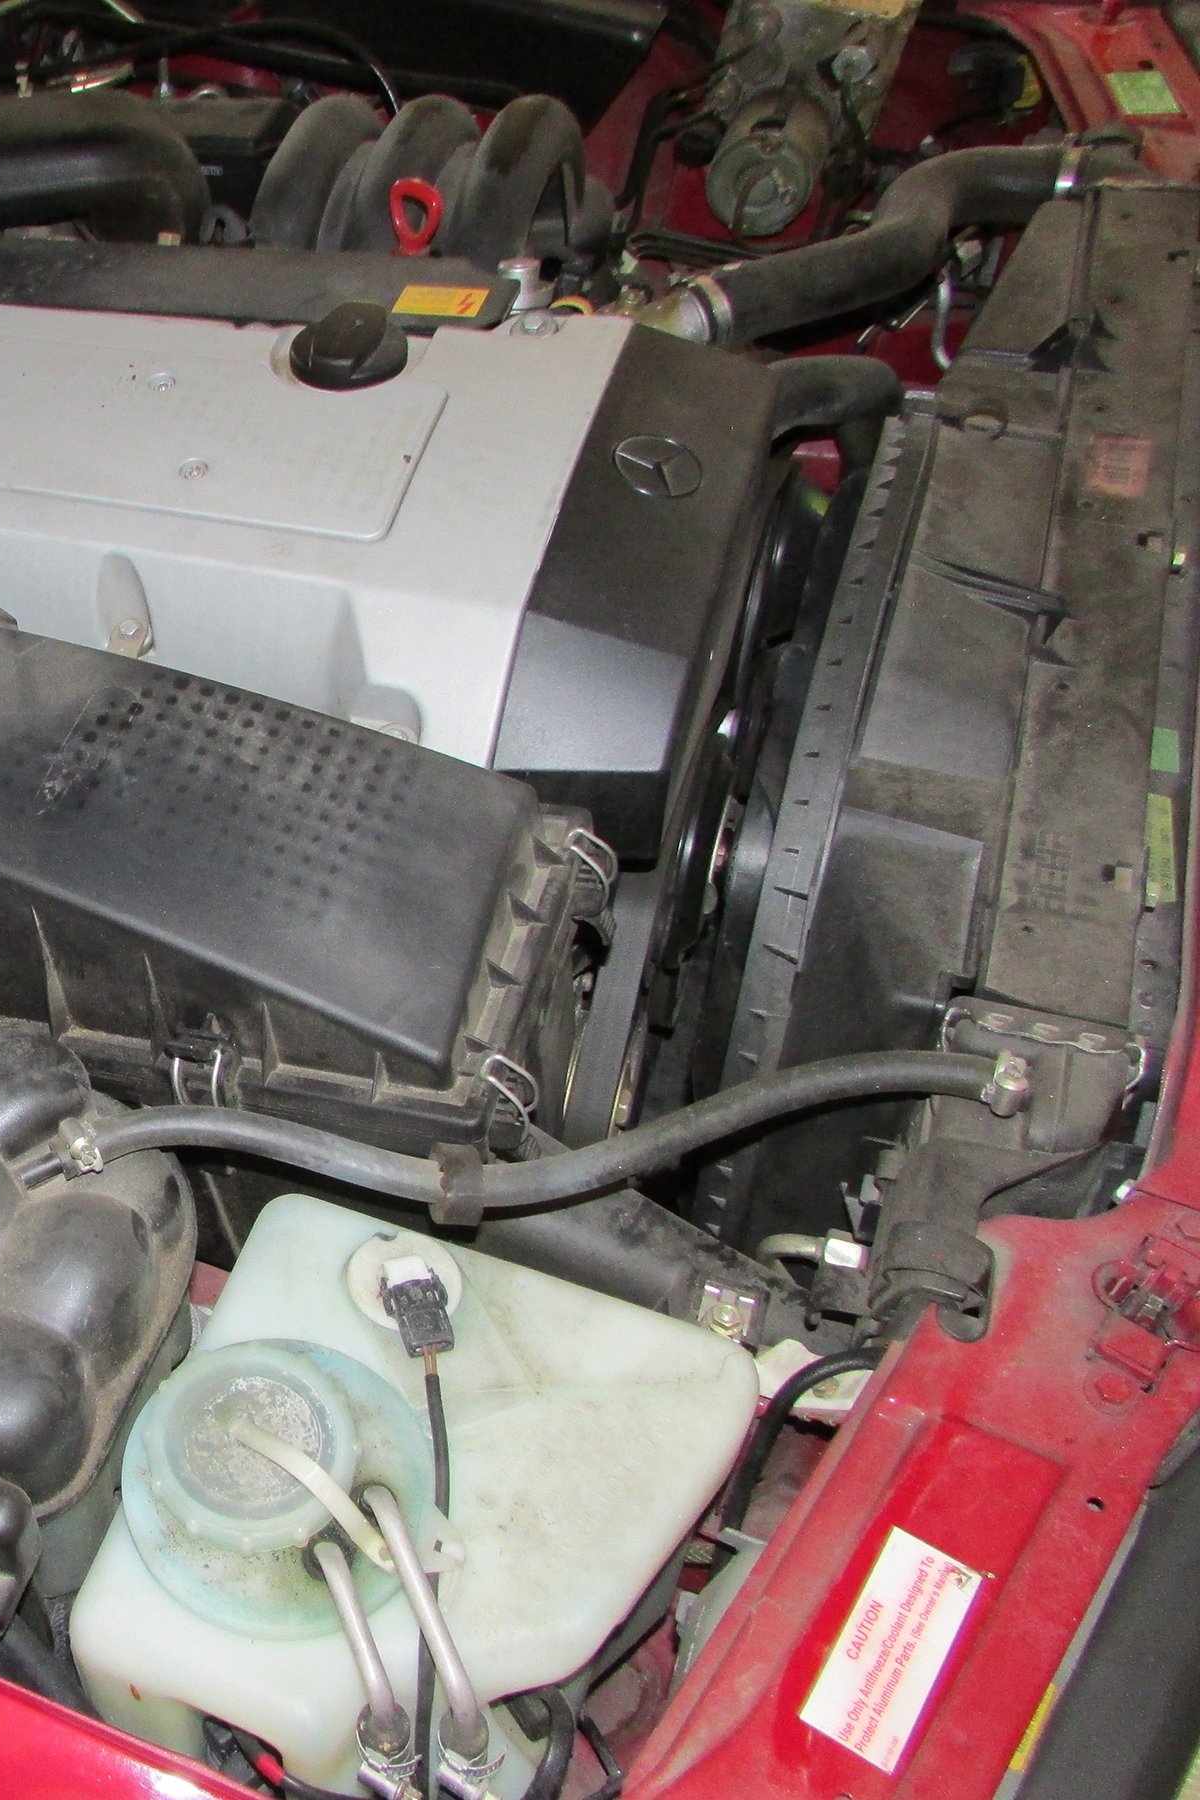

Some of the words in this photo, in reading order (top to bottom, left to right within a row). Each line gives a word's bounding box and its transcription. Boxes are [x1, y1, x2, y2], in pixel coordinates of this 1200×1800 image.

[918, 1590, 940, 1620] Owner's
[847, 1600, 883, 1661] CAUTION
[910, 1619, 927, 1640] (See
[839, 1721, 854, 1742] Use
[848, 1696, 869, 1722] Only
[860, 1611, 909, 1697] Antifreeze/Coolant
[901, 1568, 930, 1613] Designed
[921, 1555, 935, 1569] To
[895, 1638, 917, 1667] Parts.
[871, 1666, 903, 1716] Aluminum
[854, 1716, 880, 1752] Protect
